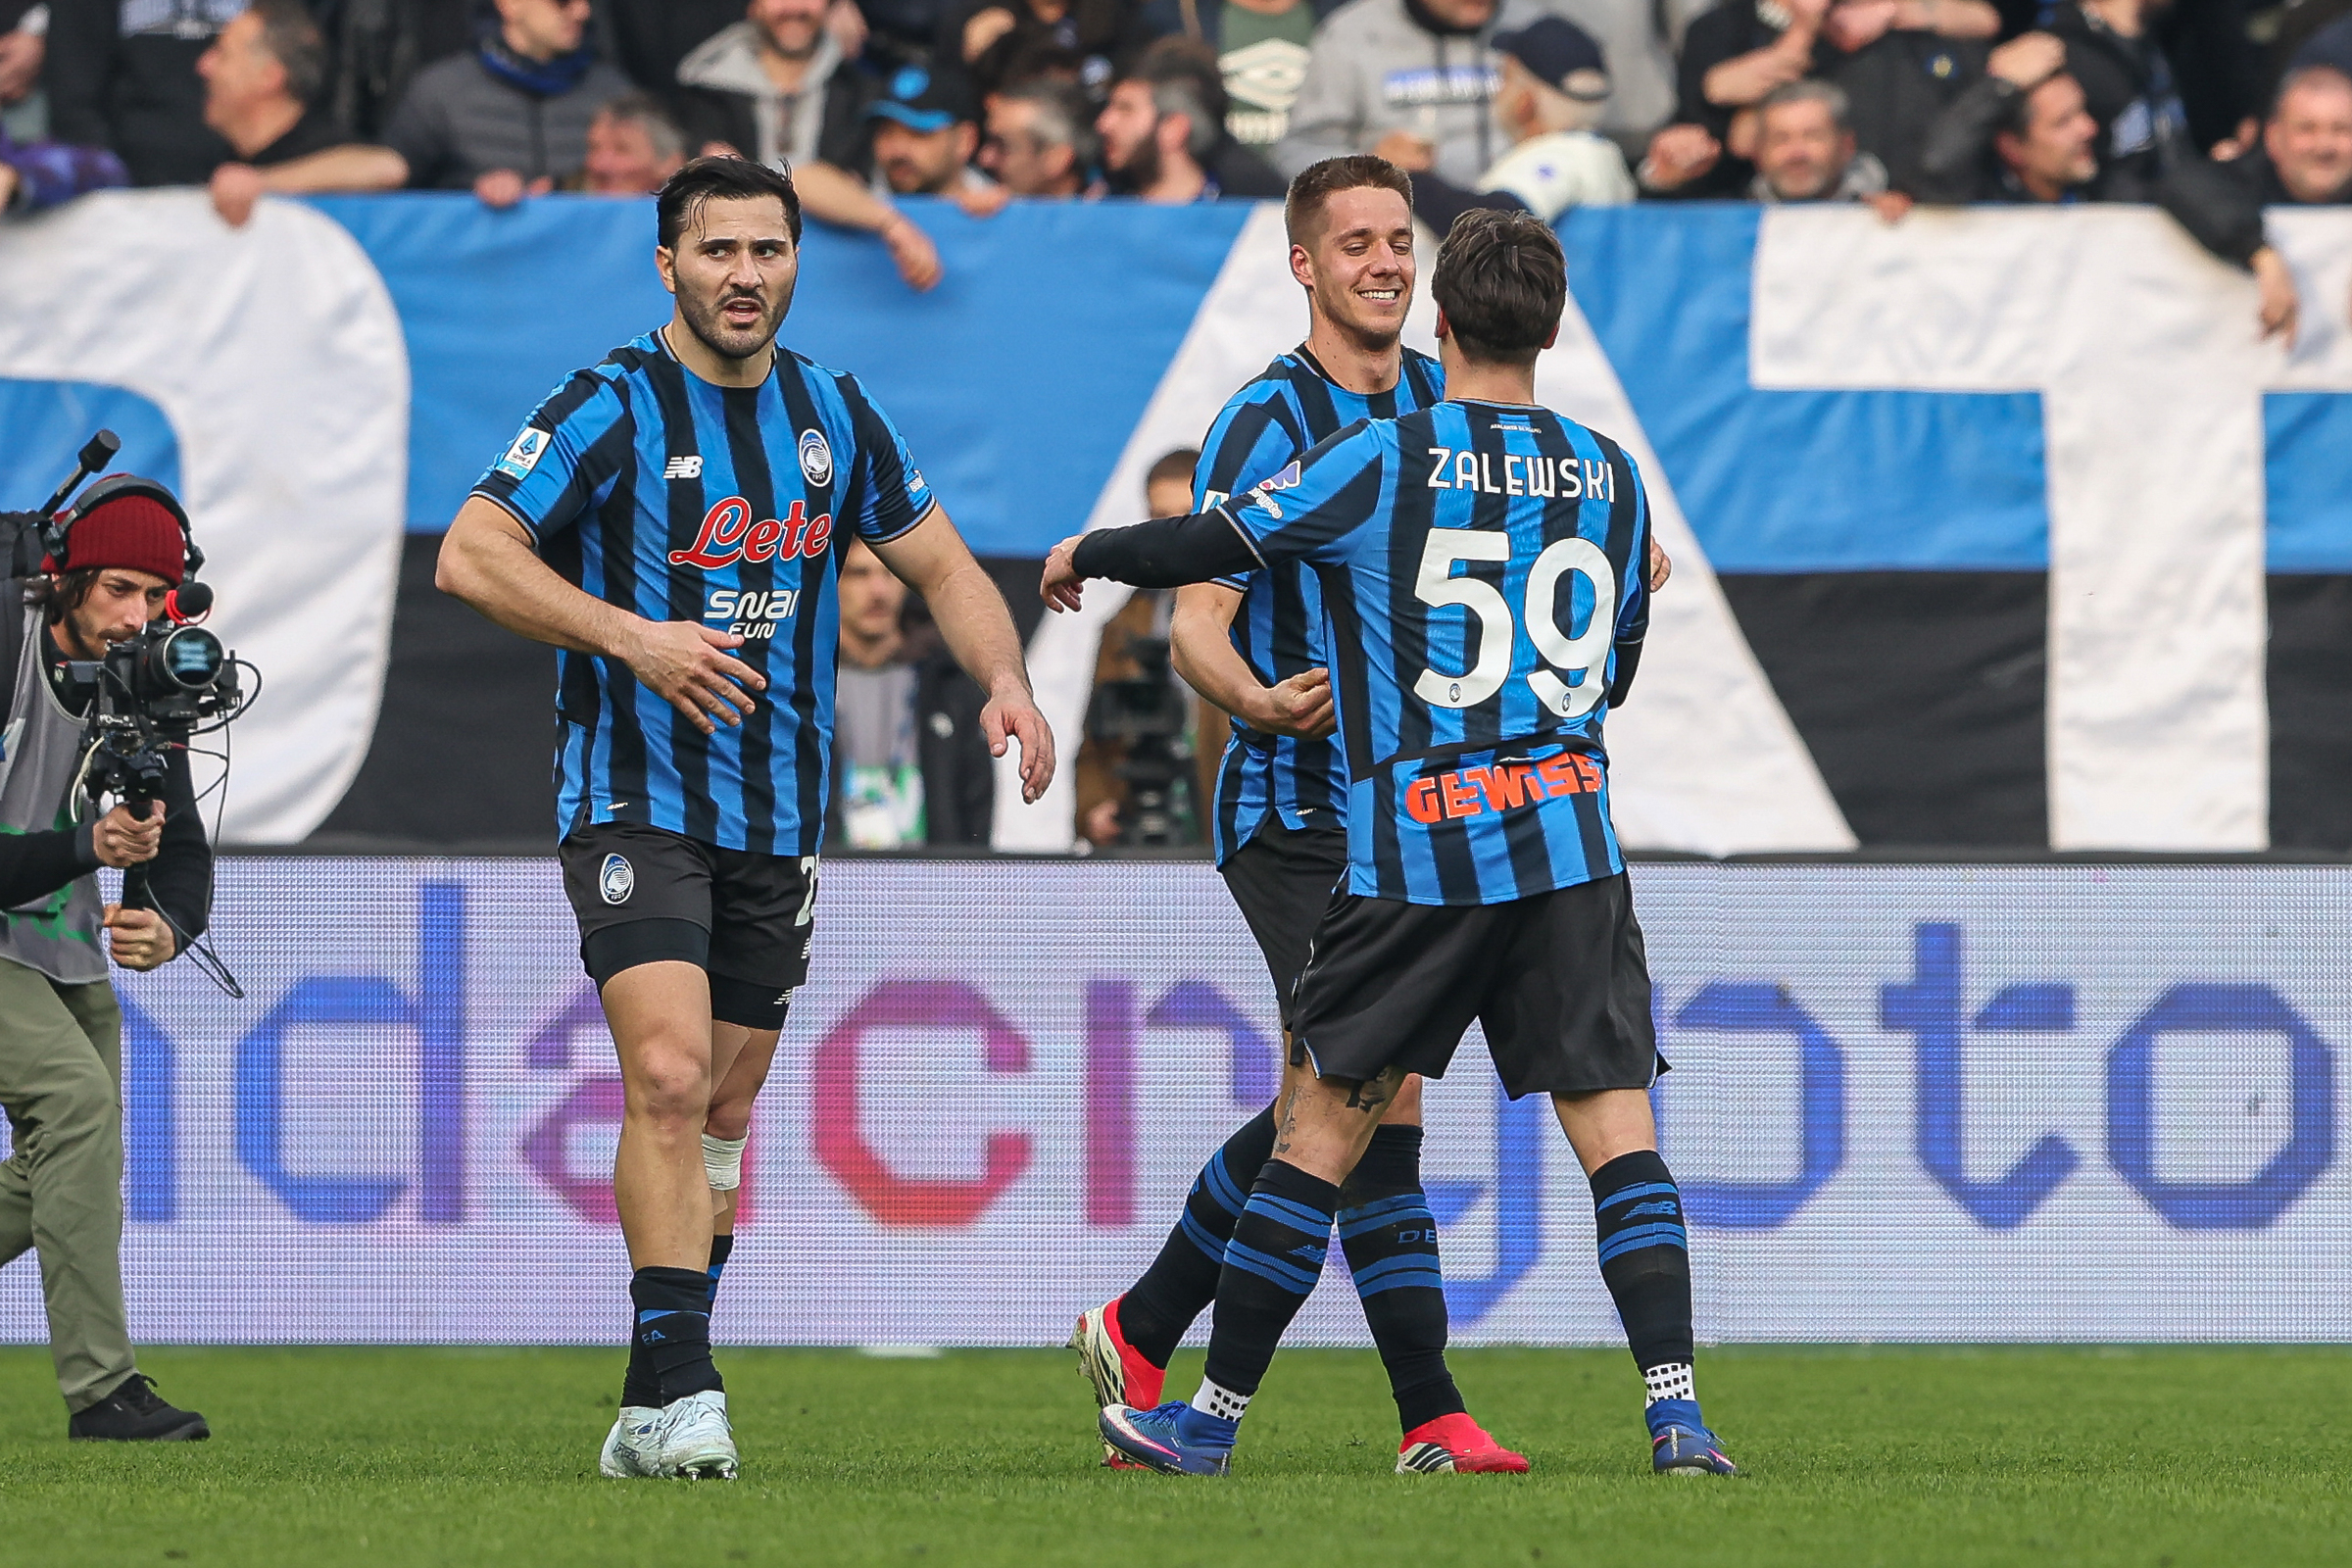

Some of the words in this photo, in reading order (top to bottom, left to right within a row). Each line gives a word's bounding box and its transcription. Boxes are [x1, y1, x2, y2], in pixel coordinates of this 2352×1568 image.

[1427, 447, 1616, 504] ZALEWSKI
[667, 495, 832, 570] Lete
[1413, 526, 1617, 719] 59
[1404, 752, 1603, 824] GEWISS
